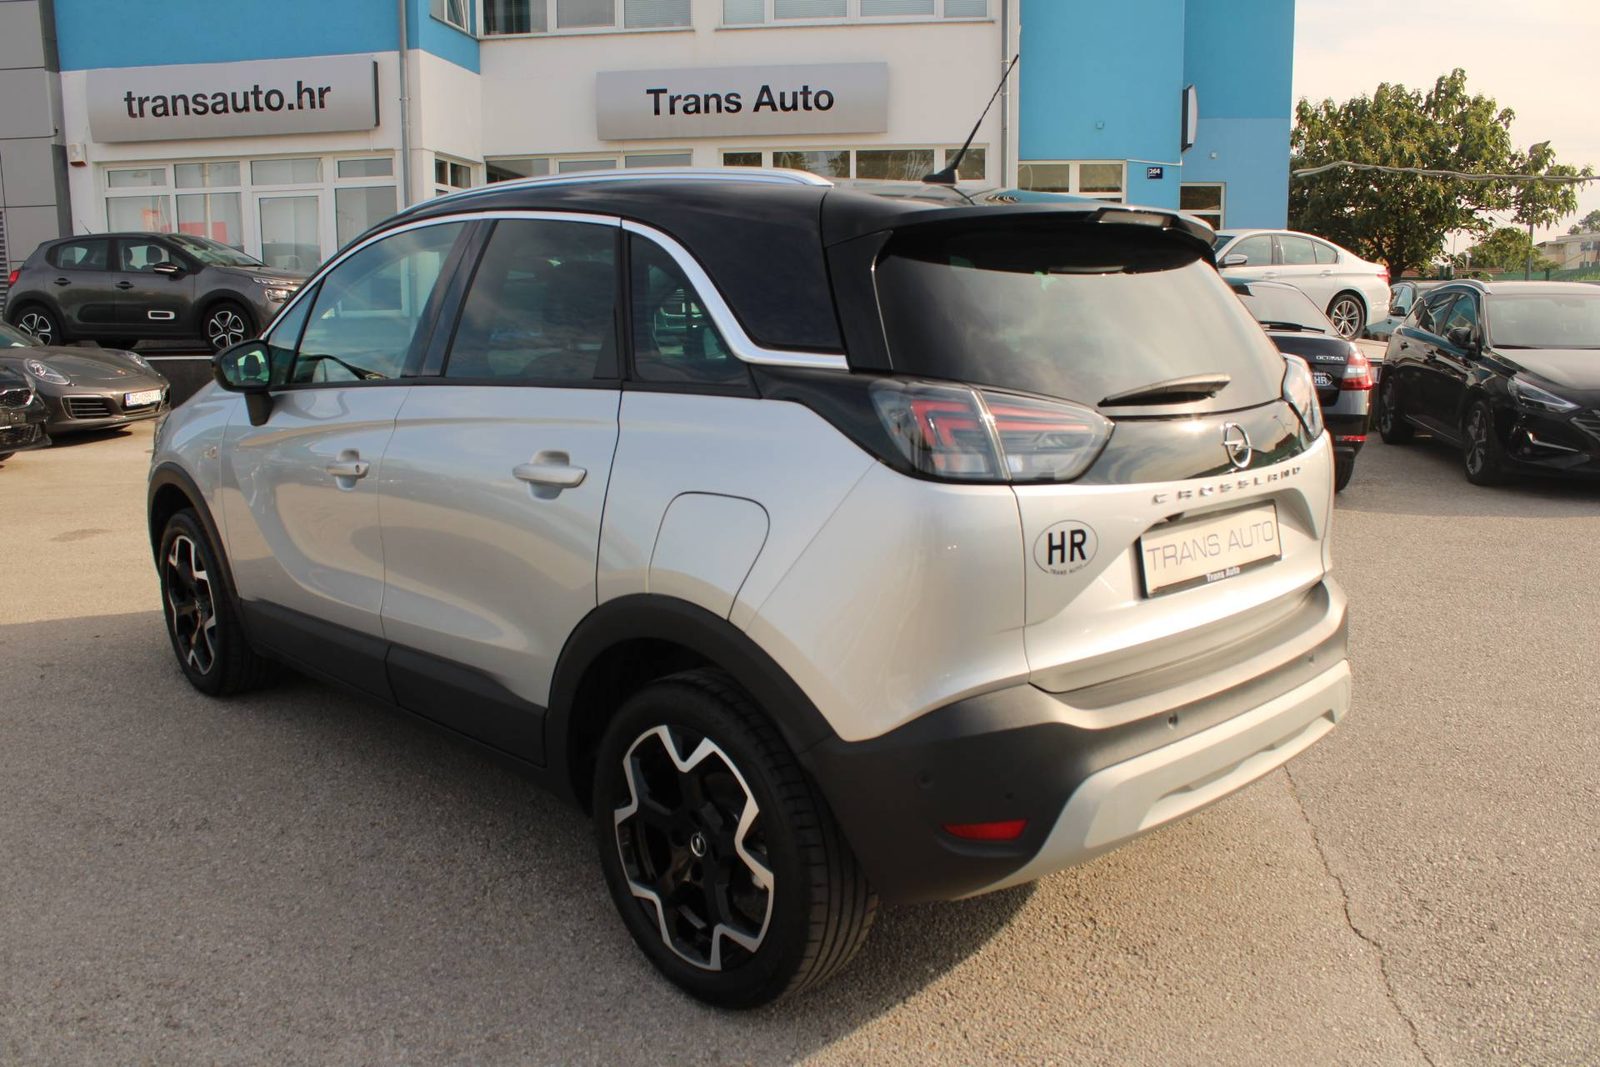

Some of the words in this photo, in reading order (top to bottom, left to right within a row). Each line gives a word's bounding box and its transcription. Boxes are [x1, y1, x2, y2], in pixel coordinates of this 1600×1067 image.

[124, 80, 332, 119] transauto.hr
[646, 88, 743, 116] Trans
[752, 85, 835, 112] Auto
[1152, 466, 1301, 504] CROSSLAND
[1047, 528, 1087, 566] HR
[1146, 533, 1221, 571] TRANS
[1228, 520, 1275, 553] AUTO
